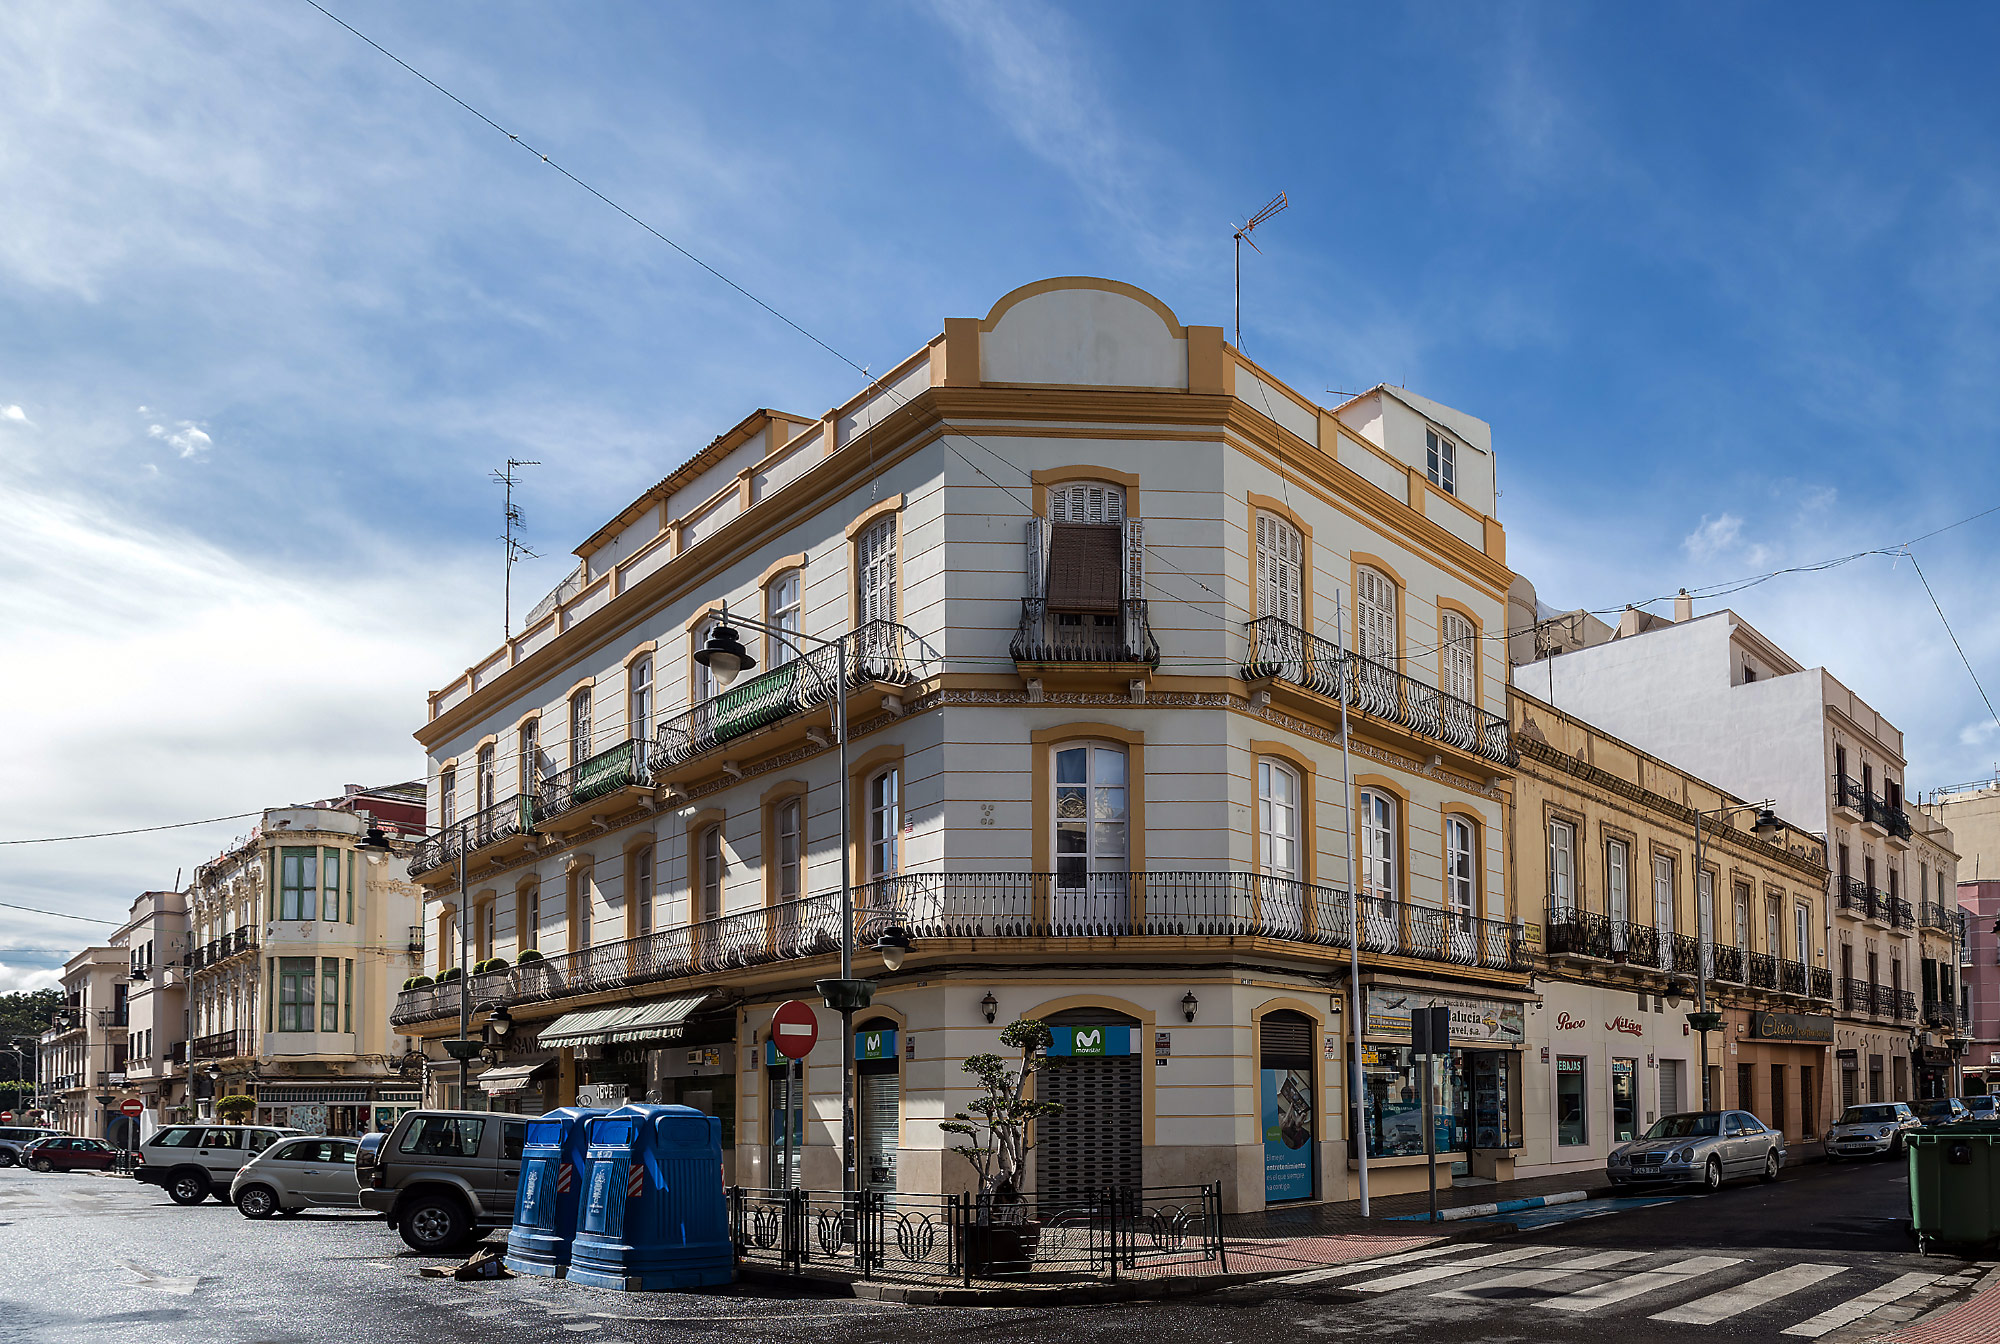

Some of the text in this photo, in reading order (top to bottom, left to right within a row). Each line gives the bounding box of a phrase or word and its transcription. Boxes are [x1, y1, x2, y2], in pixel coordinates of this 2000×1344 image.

[1556, 1011, 1643, 1037] Paco Milán
[597, 1085, 626, 1100] JOYERIA
